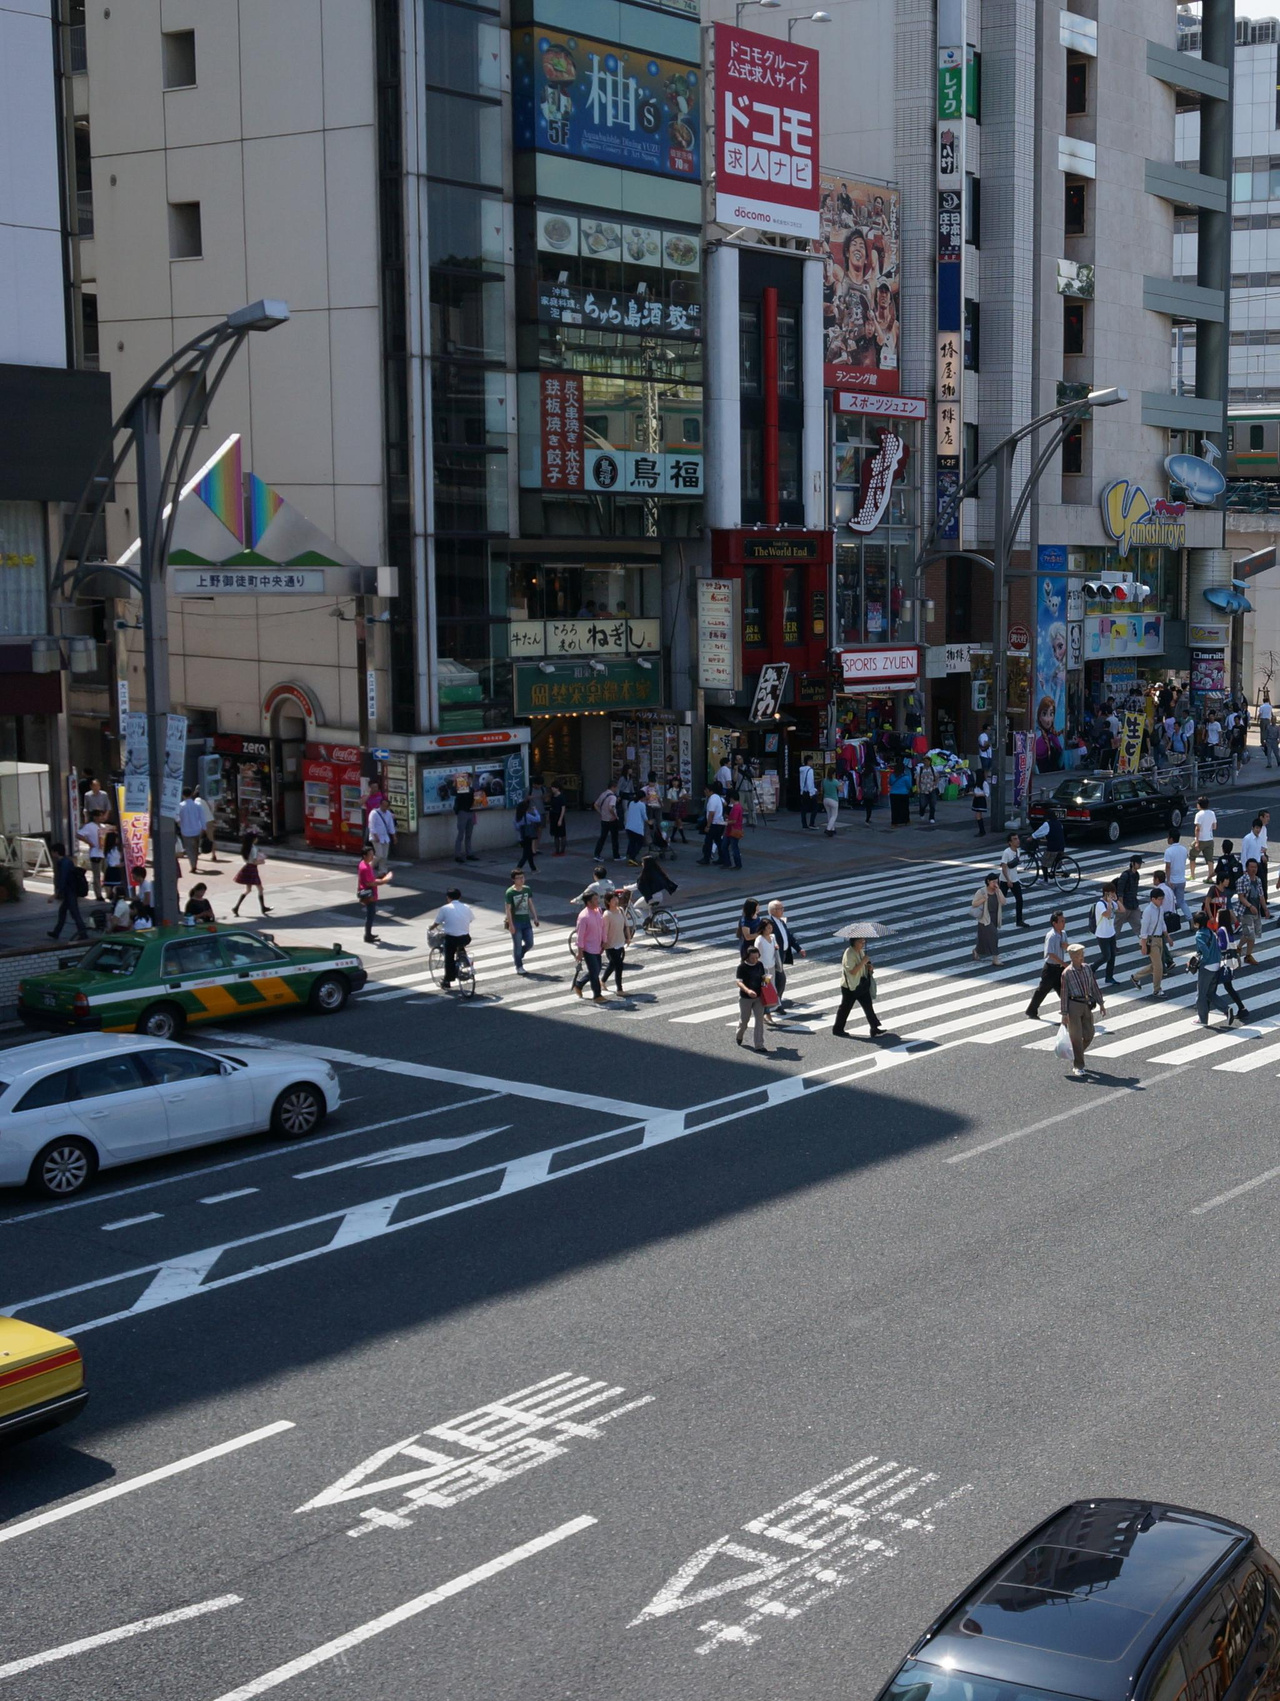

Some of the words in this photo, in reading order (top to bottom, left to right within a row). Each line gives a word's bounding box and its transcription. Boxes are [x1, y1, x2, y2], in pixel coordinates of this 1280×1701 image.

[729, 40, 809, 76] ドコモグループ
[727, 59, 808, 95] 公式求人サイト
[944, 72, 957, 114] レイク
[547, 119, 570, 147] 5F
[724, 90, 814, 156] ドコモ
[728, 147, 809, 183] 求人ナビ
[734, 206, 771, 223] docomo
[939, 212, 950, 235] 庄や
[949, 212, 960, 246] 日本海
[687, 303, 700, 316] 4F
[835, 370, 878, 386] ランニング館
[849, 395, 919, 415] スポーツジュエン
[544, 378, 562, 484] 鉄板焼き餃子
[1105, 479, 1187, 558] Yamashiroya
[753, 546, 770, 557] The
[768, 546, 792, 557] World
[793, 546, 808, 557] End
[196, 575, 305, 588] 上野御徒町中央通り
[510, 632, 542, 647] 牛たん
[587, 622, 645, 652] ねぎし
[845, 657, 878, 673] SPORTS
[882, 655, 914, 670] ZYUEN
[242, 741, 266, 755] zero
